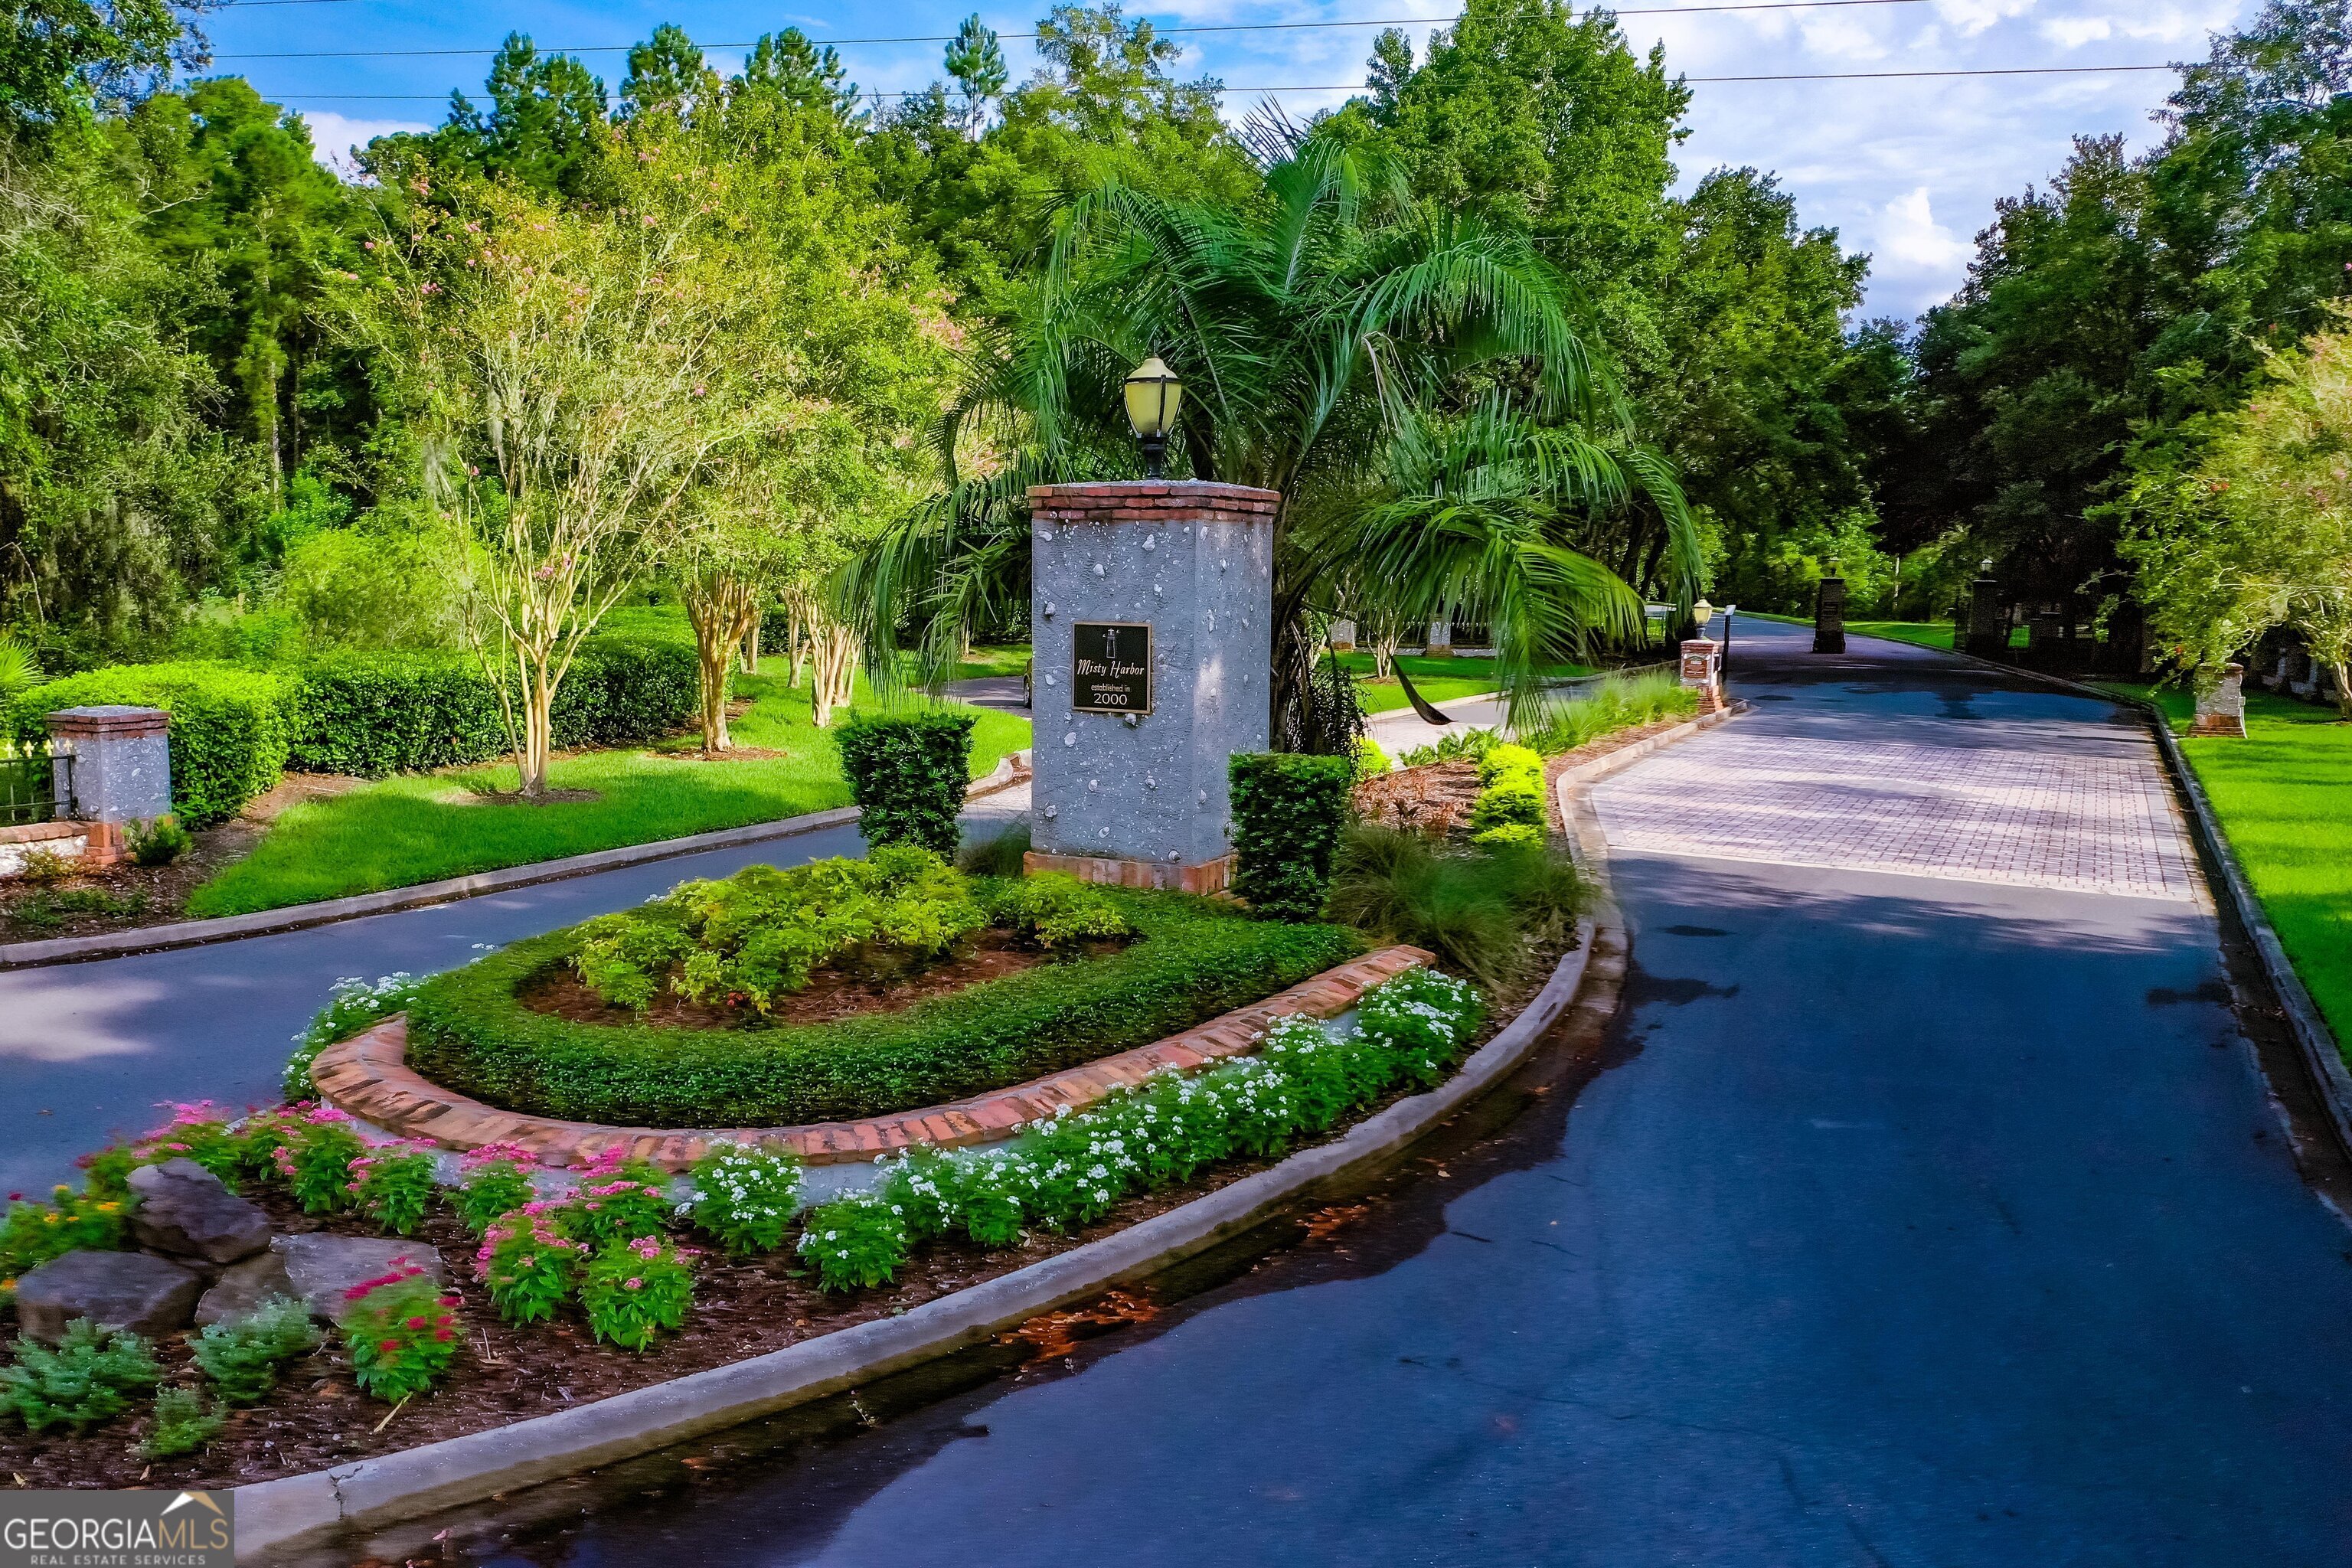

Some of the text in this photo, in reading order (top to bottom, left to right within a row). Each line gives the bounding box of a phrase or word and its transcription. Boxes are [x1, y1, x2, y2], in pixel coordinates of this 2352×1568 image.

[1077, 659, 1145, 678] Misty Harbor
[1091, 683, 1123, 692] established
[1093, 693, 1127, 705] 2000
